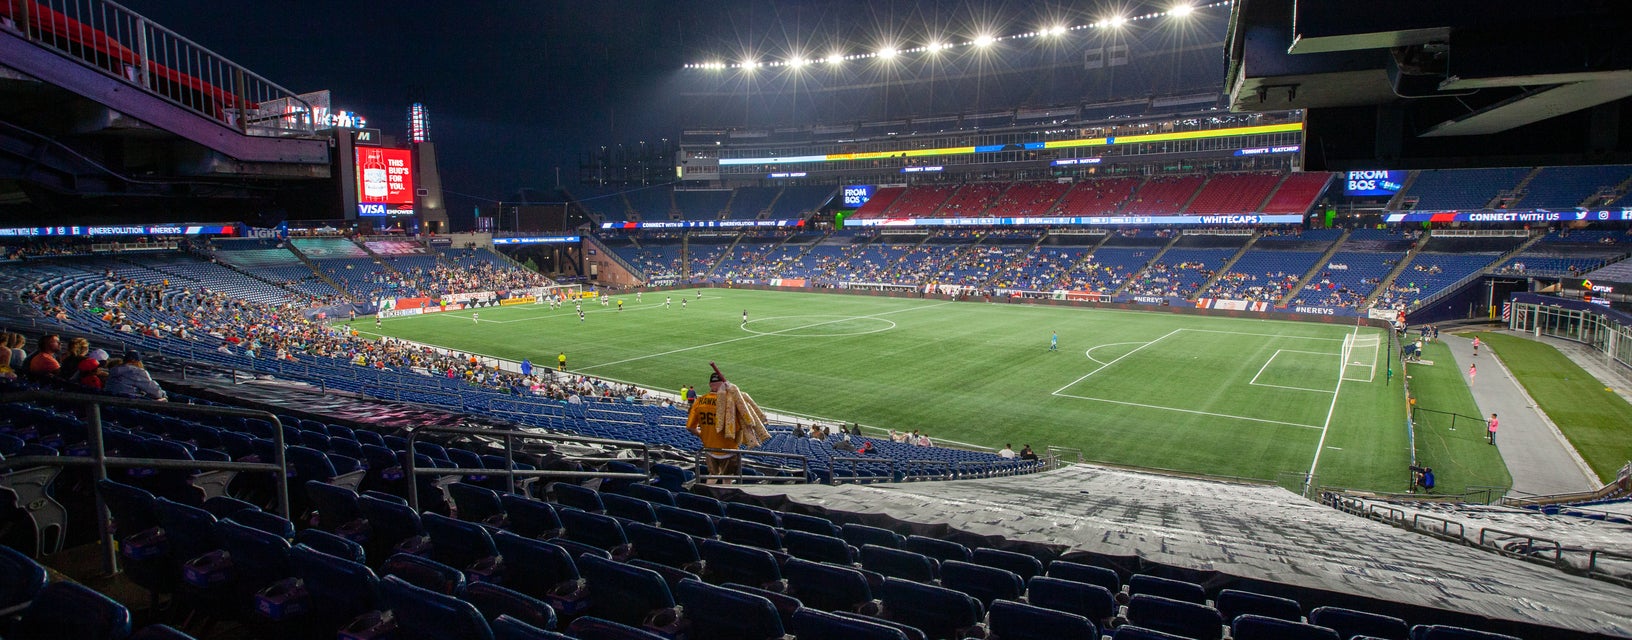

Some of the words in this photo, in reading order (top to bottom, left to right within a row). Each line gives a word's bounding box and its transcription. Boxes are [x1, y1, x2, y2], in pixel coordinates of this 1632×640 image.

[357, 132, 371, 141] M
[388, 159, 404, 167] THIS
[388, 167, 409, 175] BUD'S
[1348, 170, 1389, 180] FROM
[1348, 180, 1376, 190] BOS
[844, 188, 867, 196] FROM
[844, 196, 861, 204] BOS
[359, 204, 385, 214] VISA
[1202, 215, 1258, 224] WHITECAPS
[1469, 212, 1518, 221] CONNECT
[1519, 212, 1545, 221] WITH
[1546, 212, 1560, 221] US
[30, 227, 39, 235] US
[88, 226, 144, 235] @NEREVOLUTION
[150, 226, 182, 234] #NEREVS
[247, 229, 283, 239] LIGHT
[1295, 306, 1334, 315] #NEREVS
